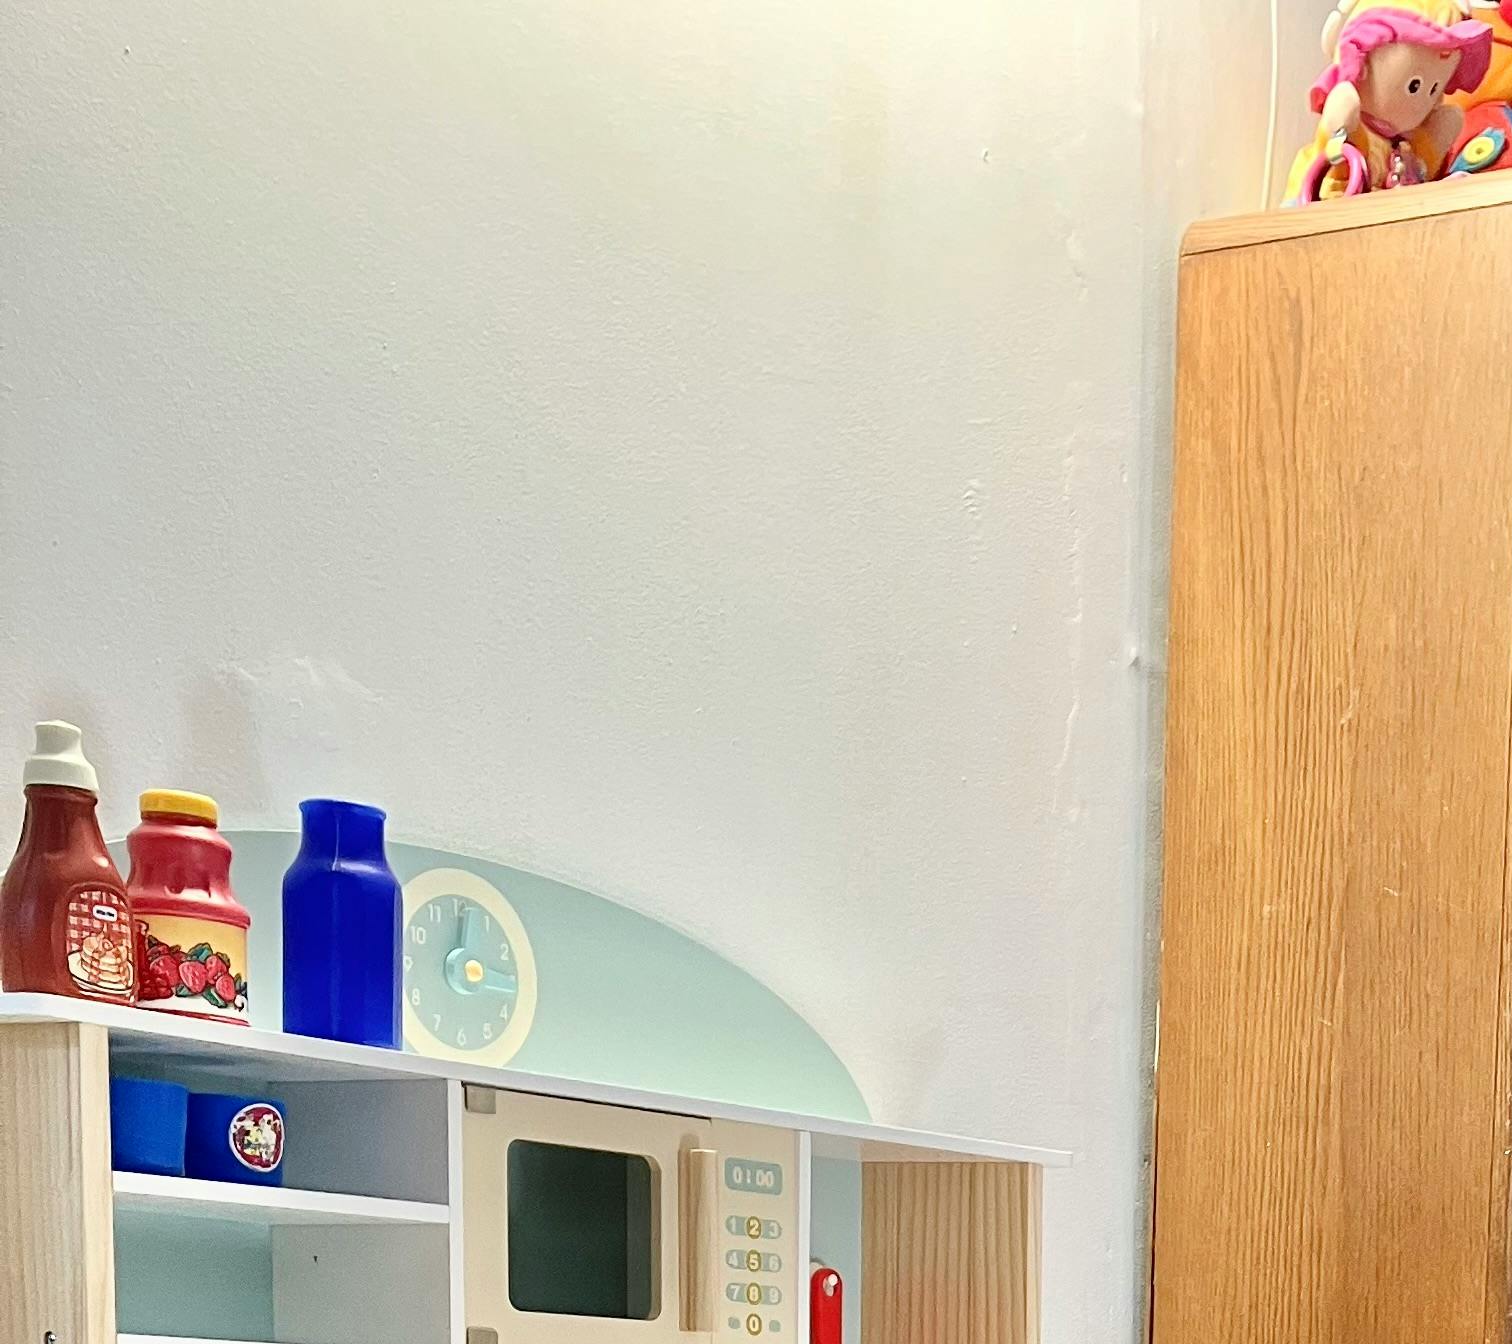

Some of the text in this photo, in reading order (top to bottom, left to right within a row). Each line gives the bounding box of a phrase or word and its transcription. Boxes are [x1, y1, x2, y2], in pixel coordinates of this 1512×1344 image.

[427, 904, 442, 923] 11
[483, 915, 491, 933] 1
[410, 925, 426, 944] 10
[499, 943, 510, 961] 2
[411, 988, 421, 1006] 8
[499, 1004, 509, 1022] 4
[432, 1013, 442, 1032] 7
[482, 1023, 493, 1040] 5
[457, 1028, 467, 1046] 6
[749, 1218, 760, 1236] 2
[768, 1222, 778, 1238] 3
[749, 1253, 759, 1270] 5
[730, 1285, 740, 1300] 7
[749, 1286, 760, 1303] 8
[748, 1316, 760, 1332] 0
